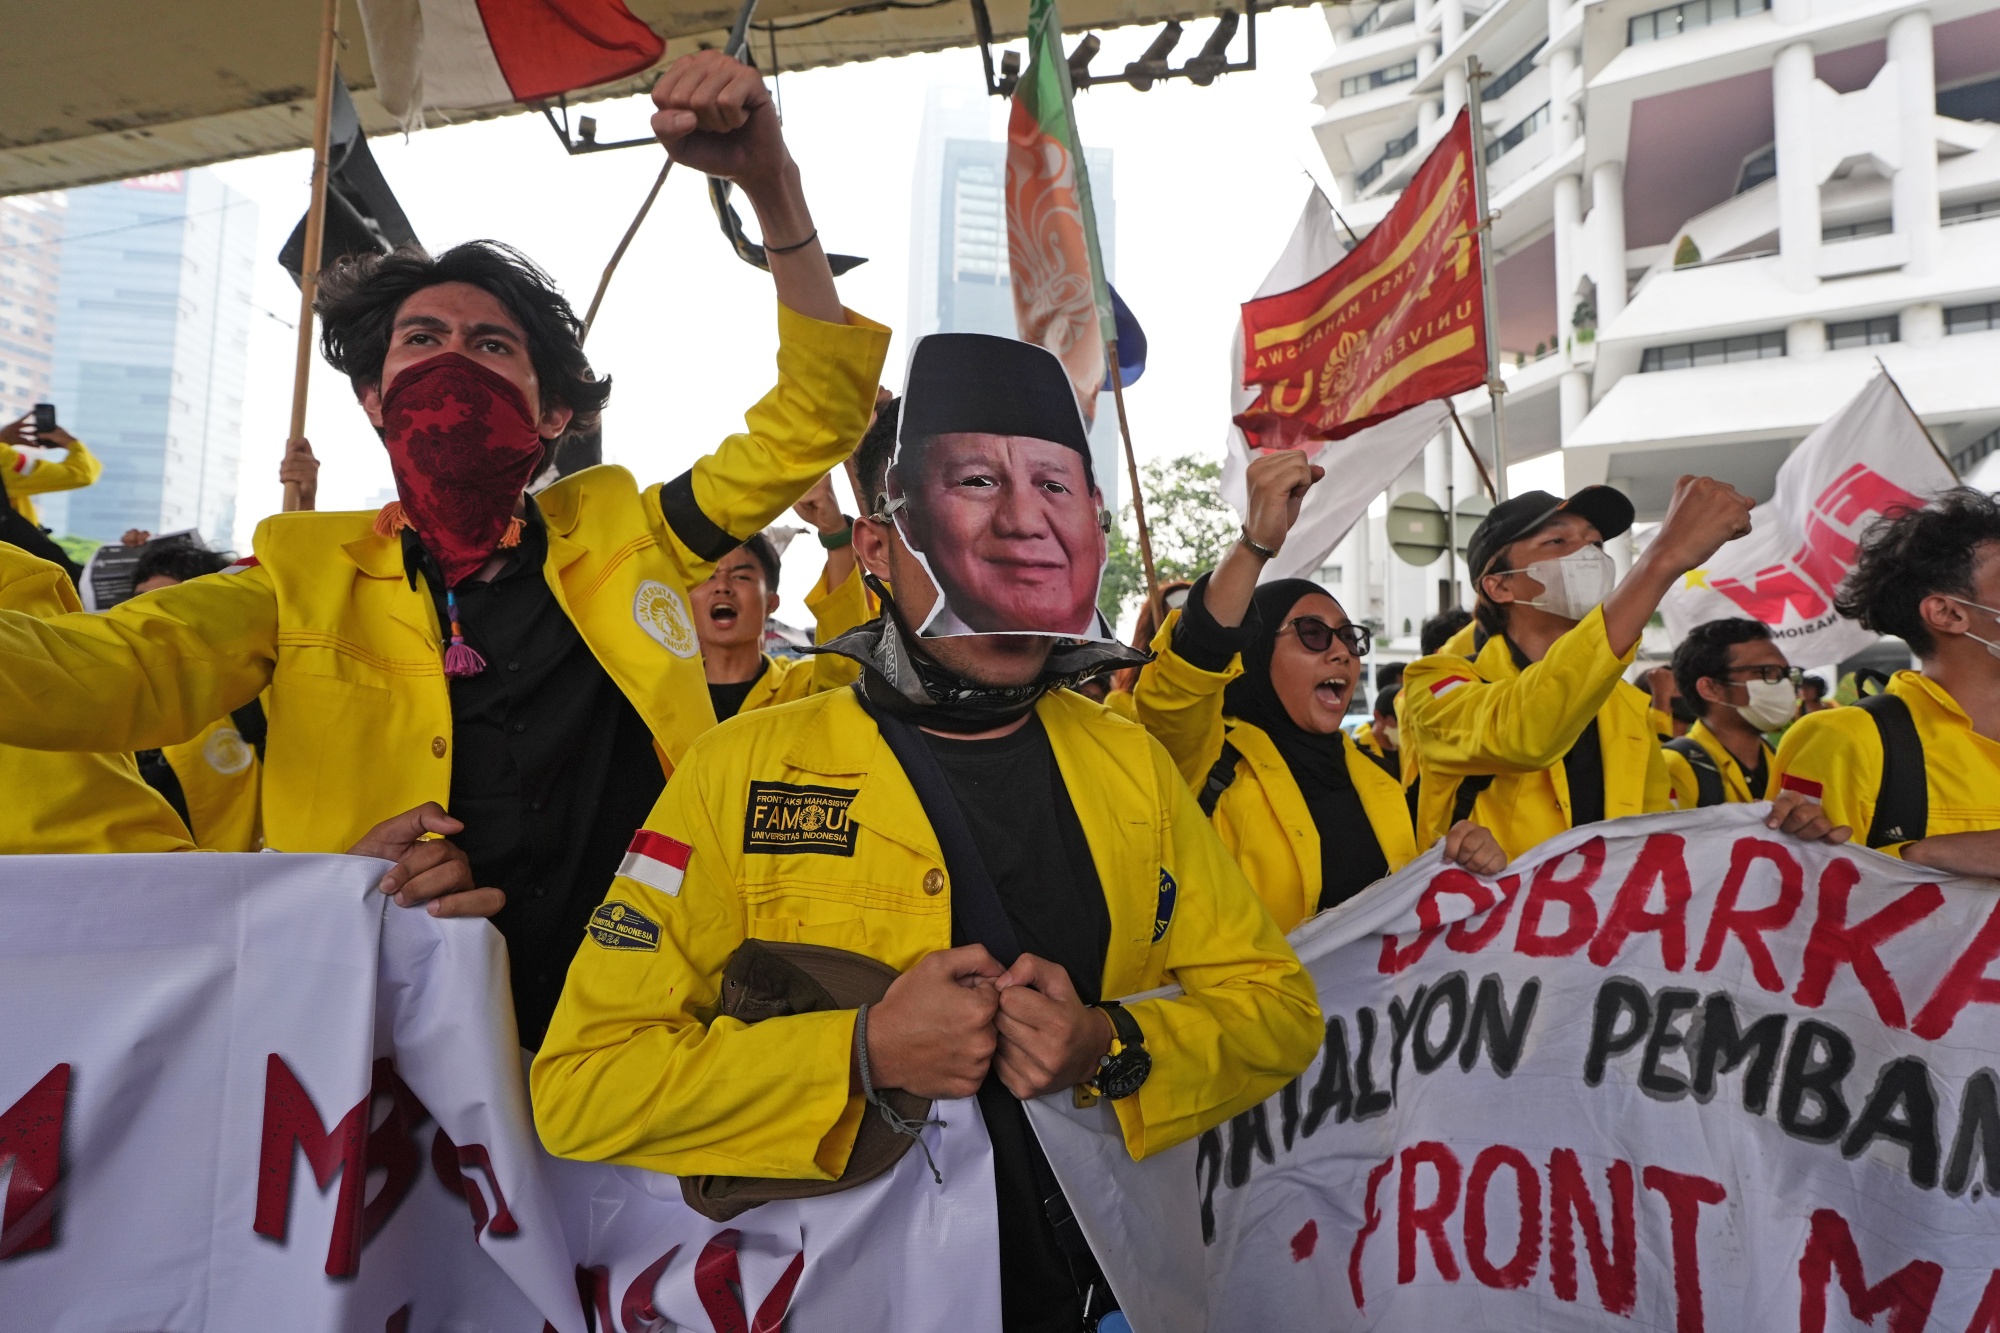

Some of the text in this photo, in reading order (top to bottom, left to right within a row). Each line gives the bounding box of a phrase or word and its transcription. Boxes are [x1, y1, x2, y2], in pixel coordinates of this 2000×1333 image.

[639, 586, 678, 622] UNIVERSITAS
[756, 795, 850, 808] FRONT AKSI MAHASISW
[753, 805, 800, 831] FAM
[751, 831, 848, 843] UNIVERSITAS INDONESIA
[615, 923, 653, 941] INDONESIA
[1798, 1208, 2000, 1333] M
